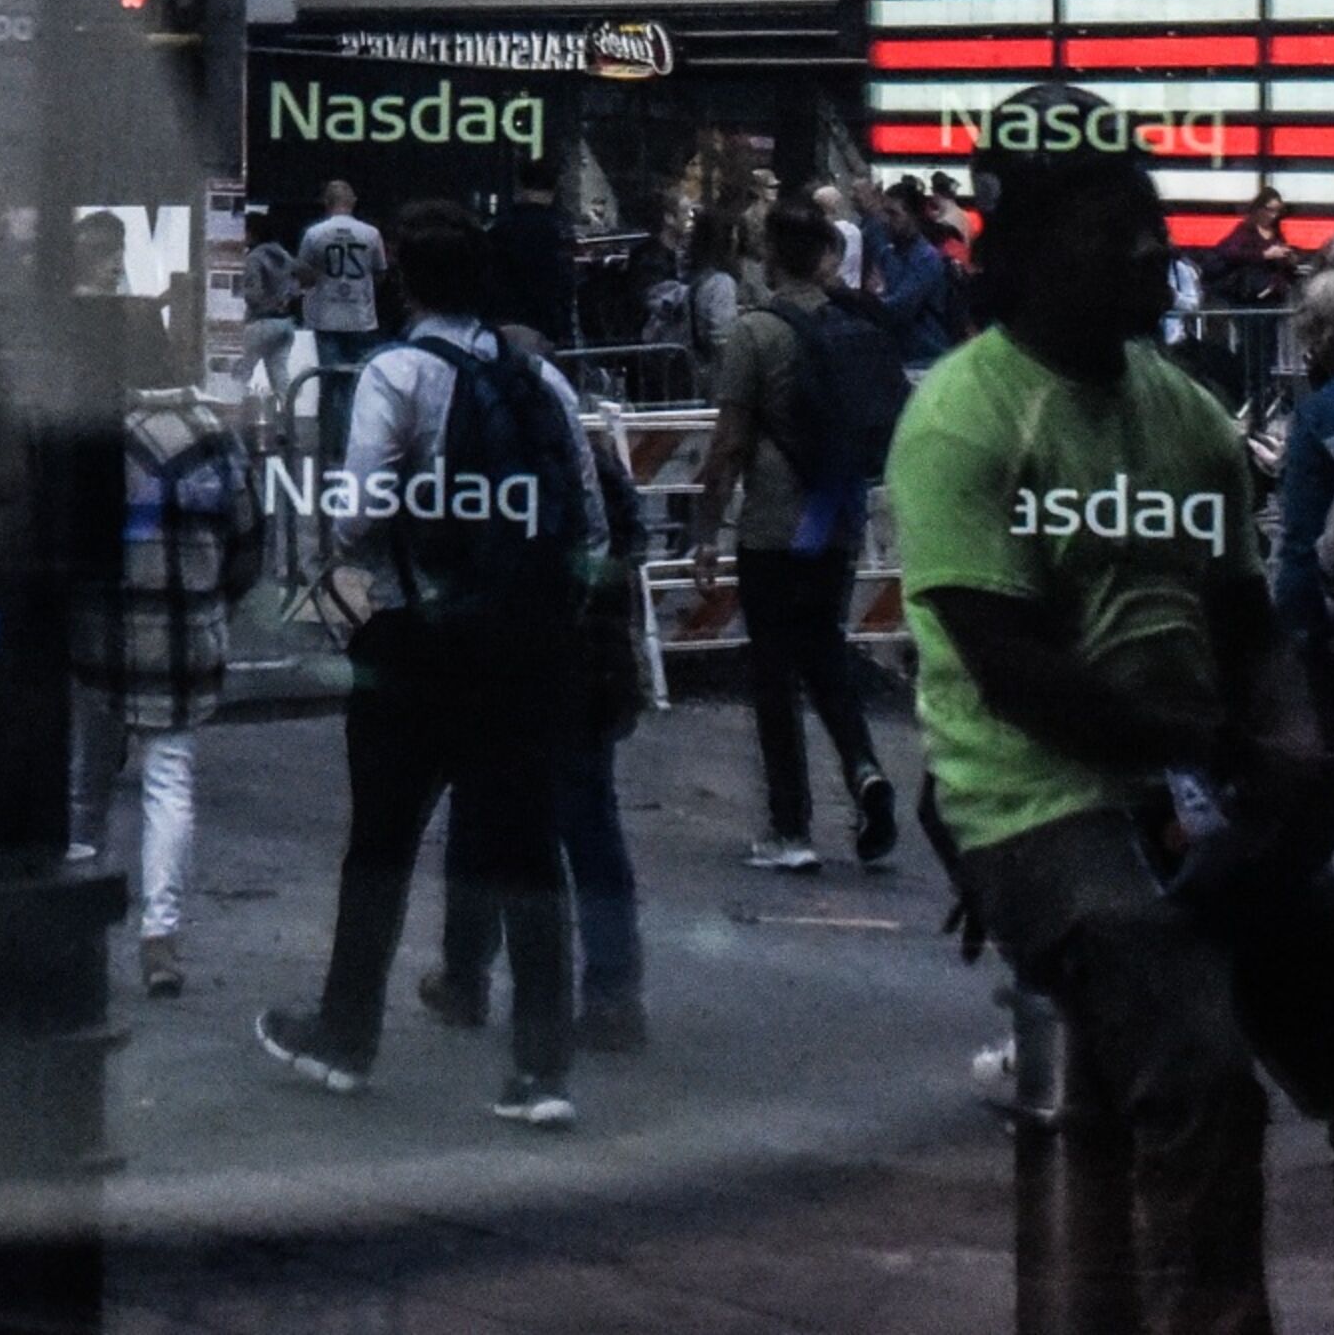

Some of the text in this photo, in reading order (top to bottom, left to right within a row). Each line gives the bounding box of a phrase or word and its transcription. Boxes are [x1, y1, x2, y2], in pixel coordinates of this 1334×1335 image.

[268, 79, 545, 161] Nasdaq
[940, 102, 1226, 167] Nasdaq
[265, 455, 540, 538] Nasdaq
[1010, 474, 1227, 557] asdaq
